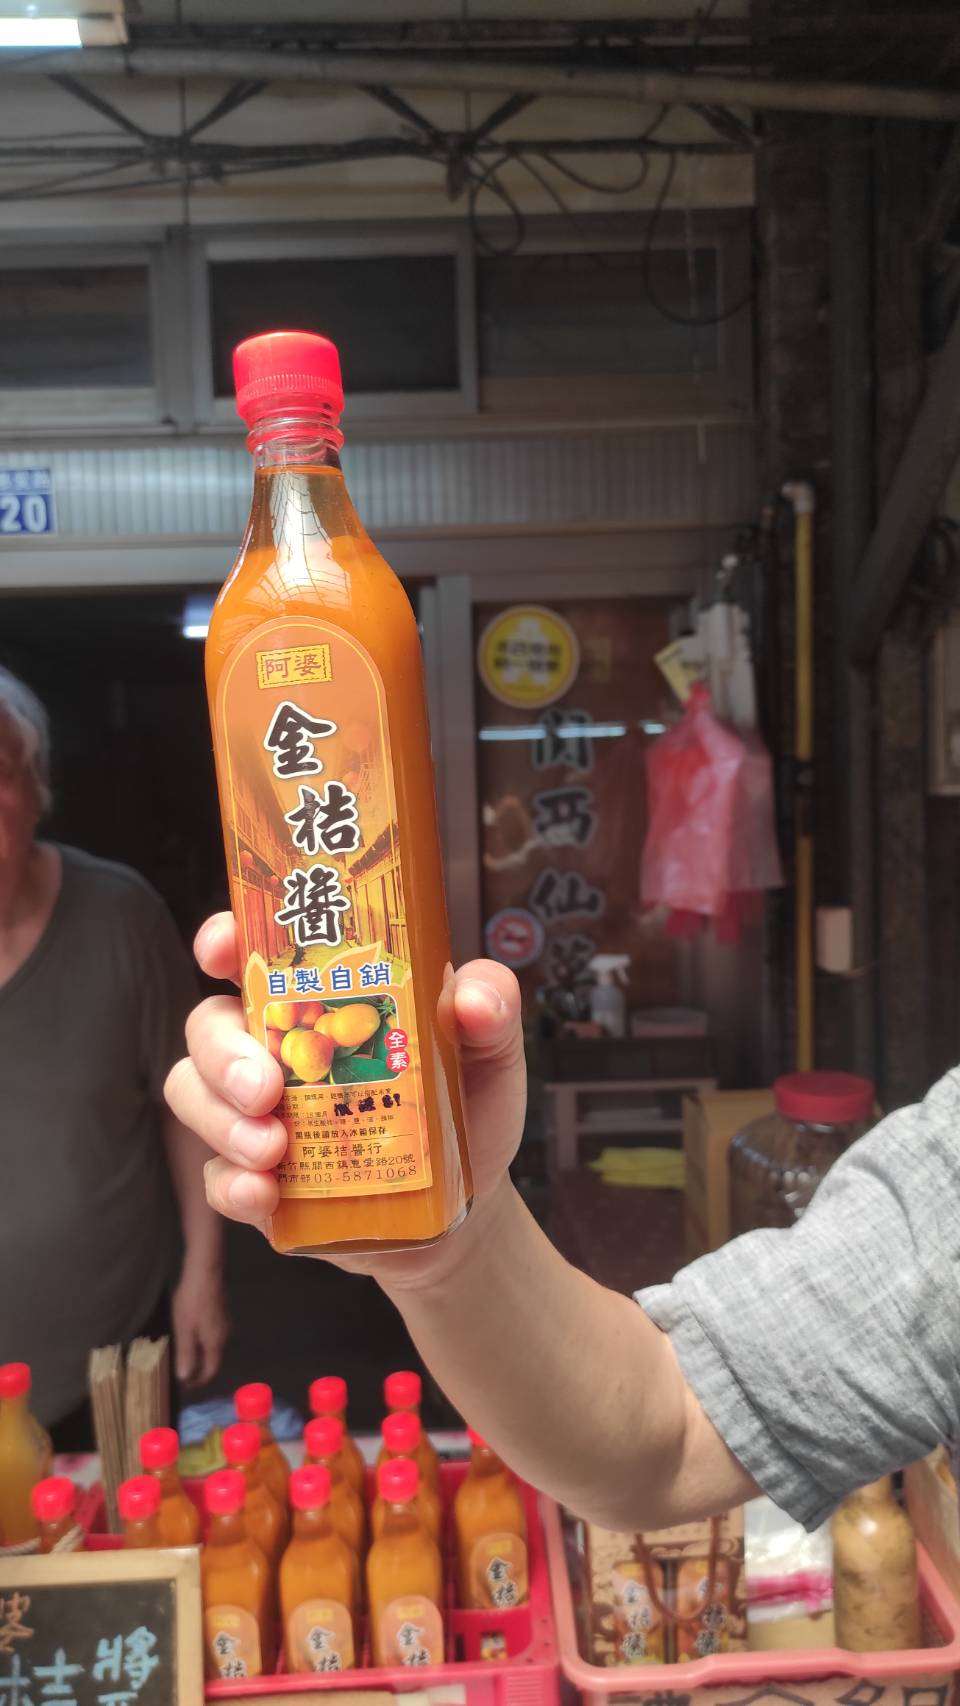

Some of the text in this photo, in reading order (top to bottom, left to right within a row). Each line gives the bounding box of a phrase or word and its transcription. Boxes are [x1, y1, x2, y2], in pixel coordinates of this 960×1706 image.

[0, 495, 47, 533] 20
[264, 653, 323, 679] 阿婆
[264, 702, 360, 946] 金桔醬
[268, 963, 391, 995] 自製自銷
[388, 1031, 408, 1070] 全素
